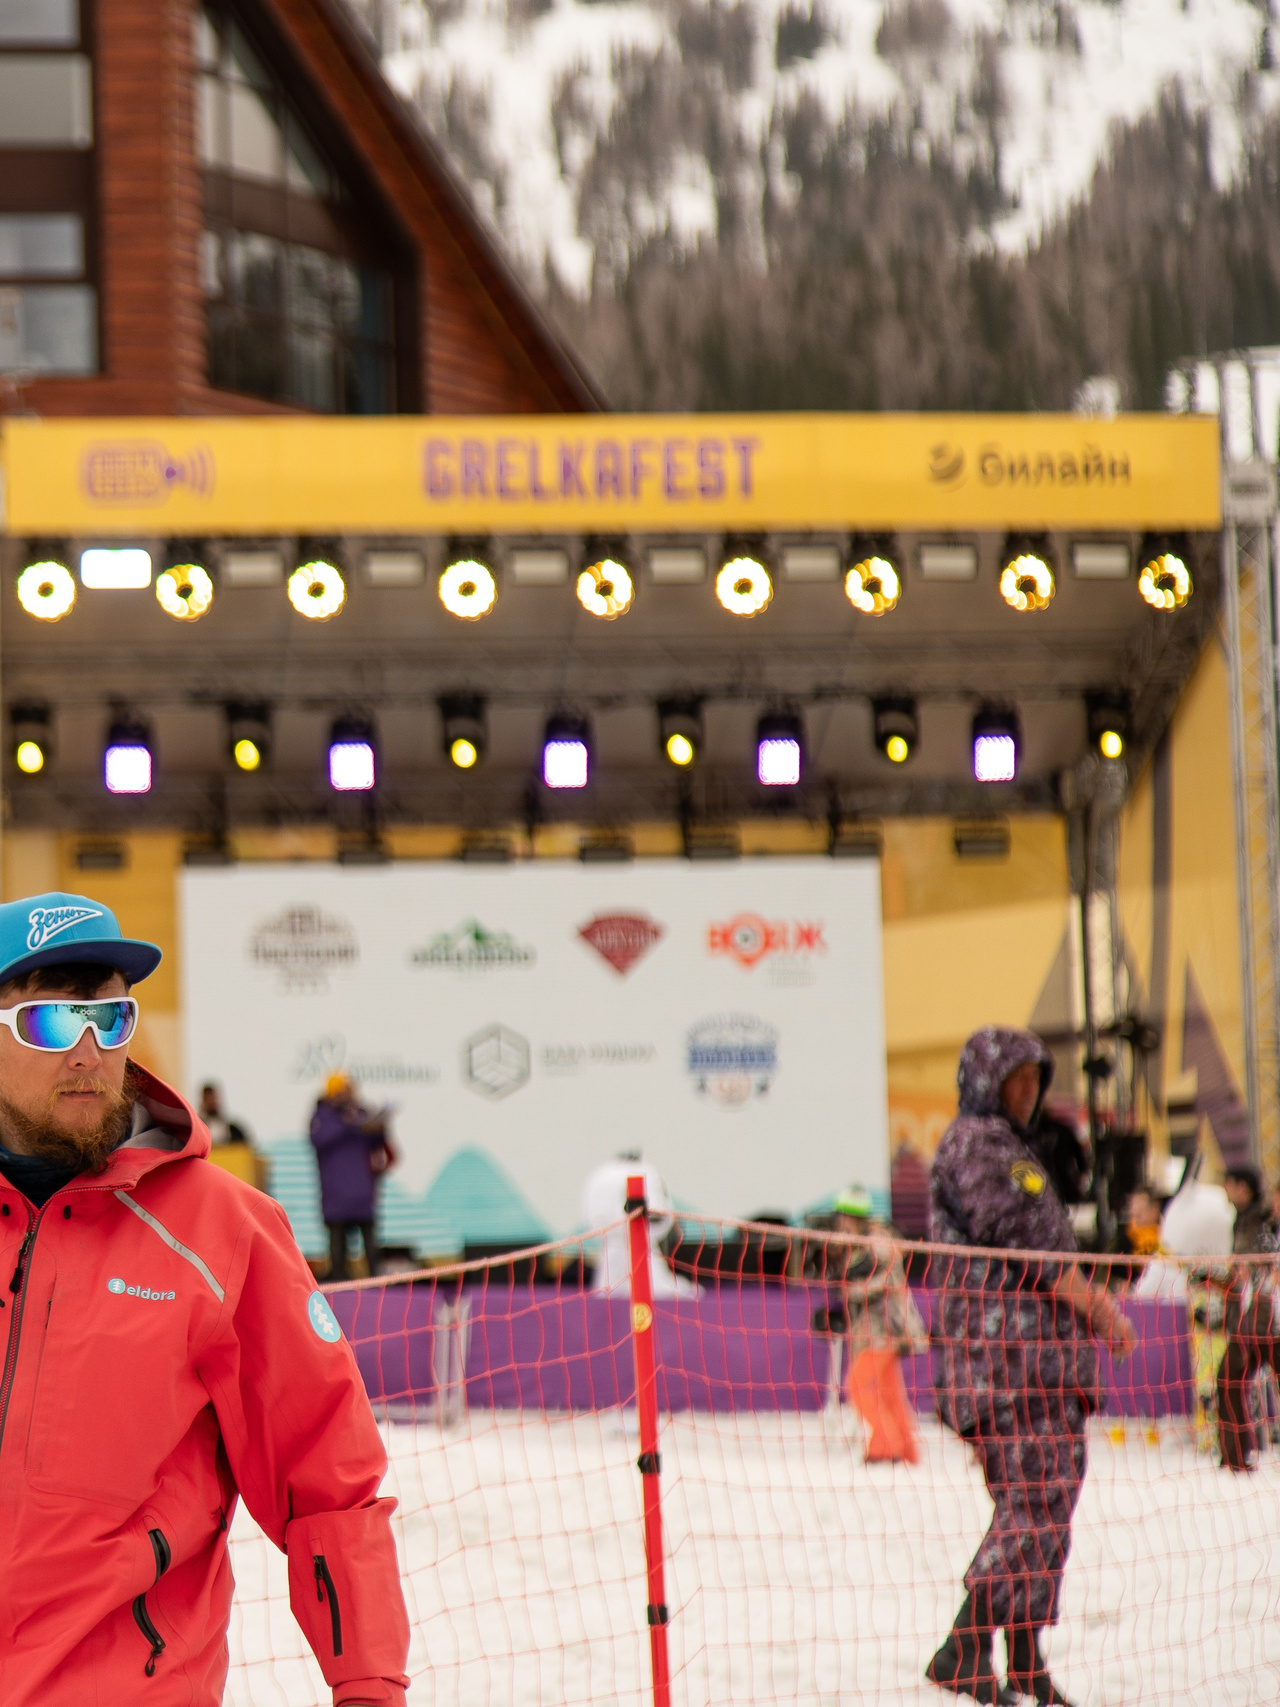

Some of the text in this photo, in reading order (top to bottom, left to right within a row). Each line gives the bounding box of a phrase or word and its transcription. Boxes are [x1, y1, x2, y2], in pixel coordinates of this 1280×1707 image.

[422, 437, 762, 503] GRELKAFEST
[978, 440, 1133, 487] билайн
[127, 1285, 176, 1301] eldora
